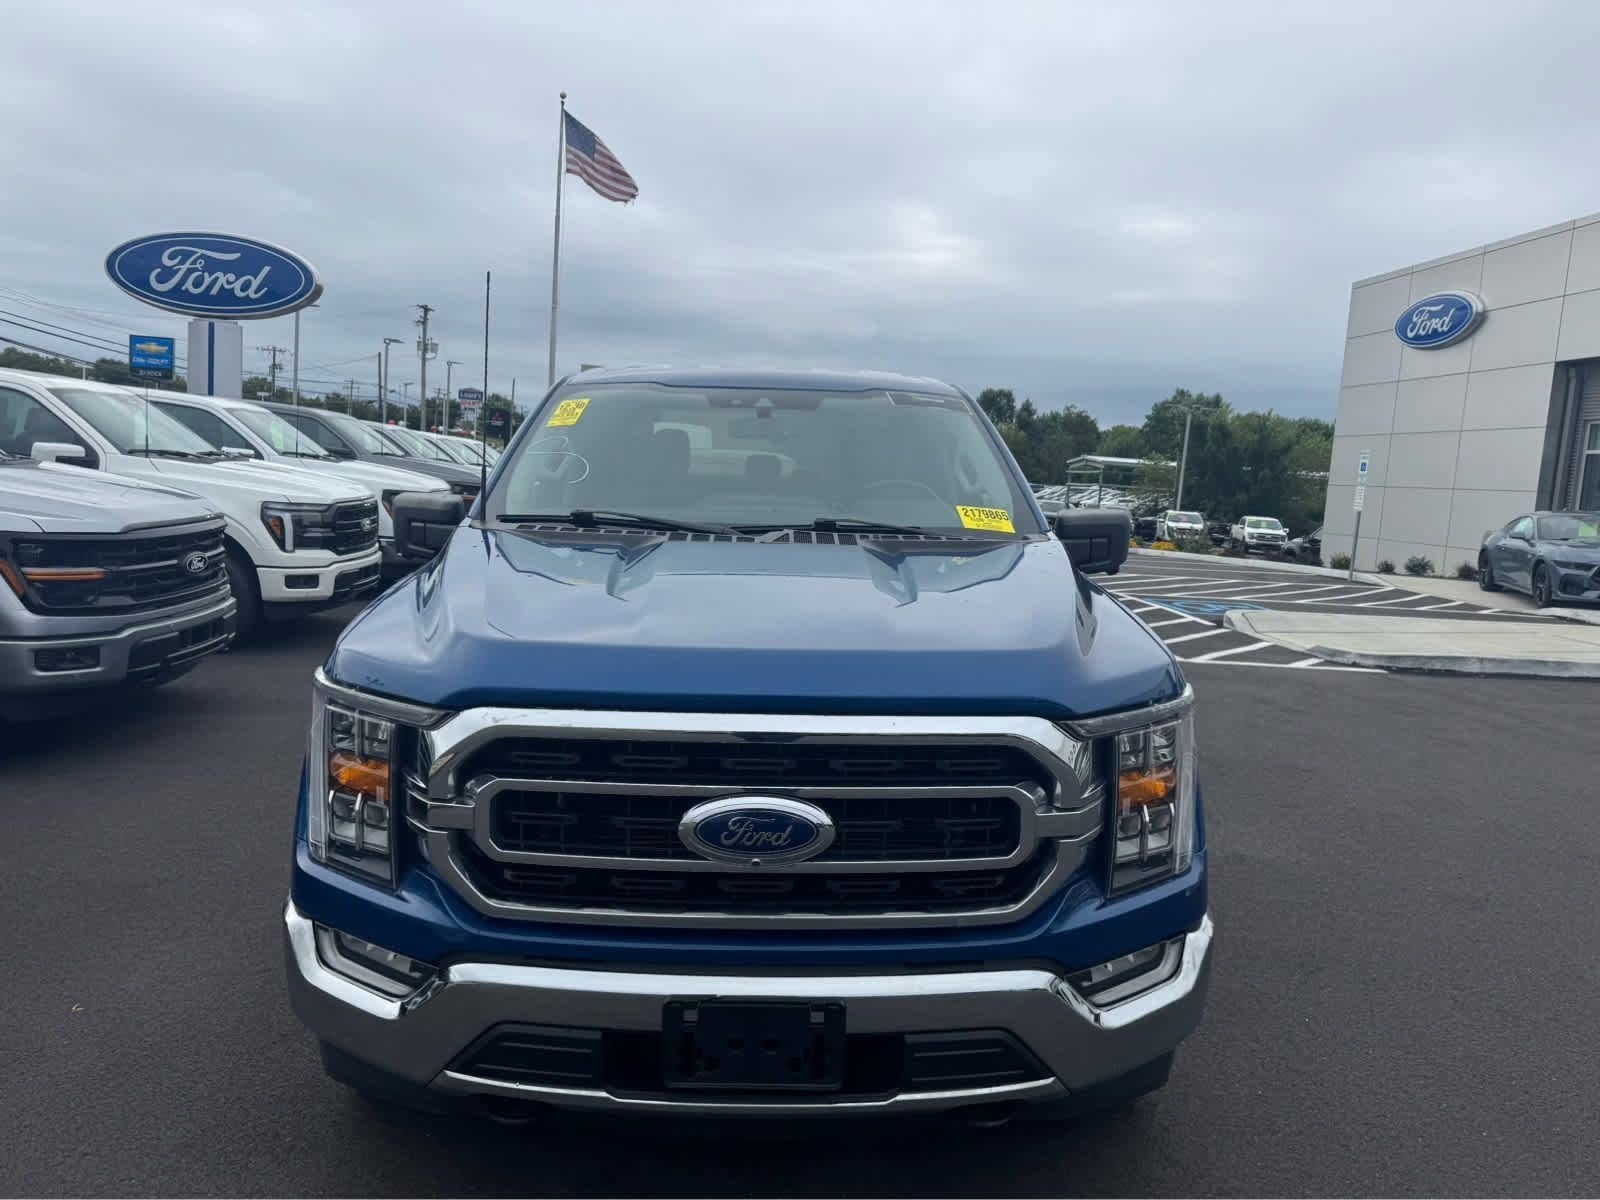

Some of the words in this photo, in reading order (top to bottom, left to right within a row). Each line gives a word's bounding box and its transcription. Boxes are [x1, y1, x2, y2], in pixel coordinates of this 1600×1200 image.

[149, 246, 272, 299] Ford
[1407, 304, 1456, 338] Ford
[961, 507, 1009, 521] 2179865
[720, 816, 793, 846] Ford
